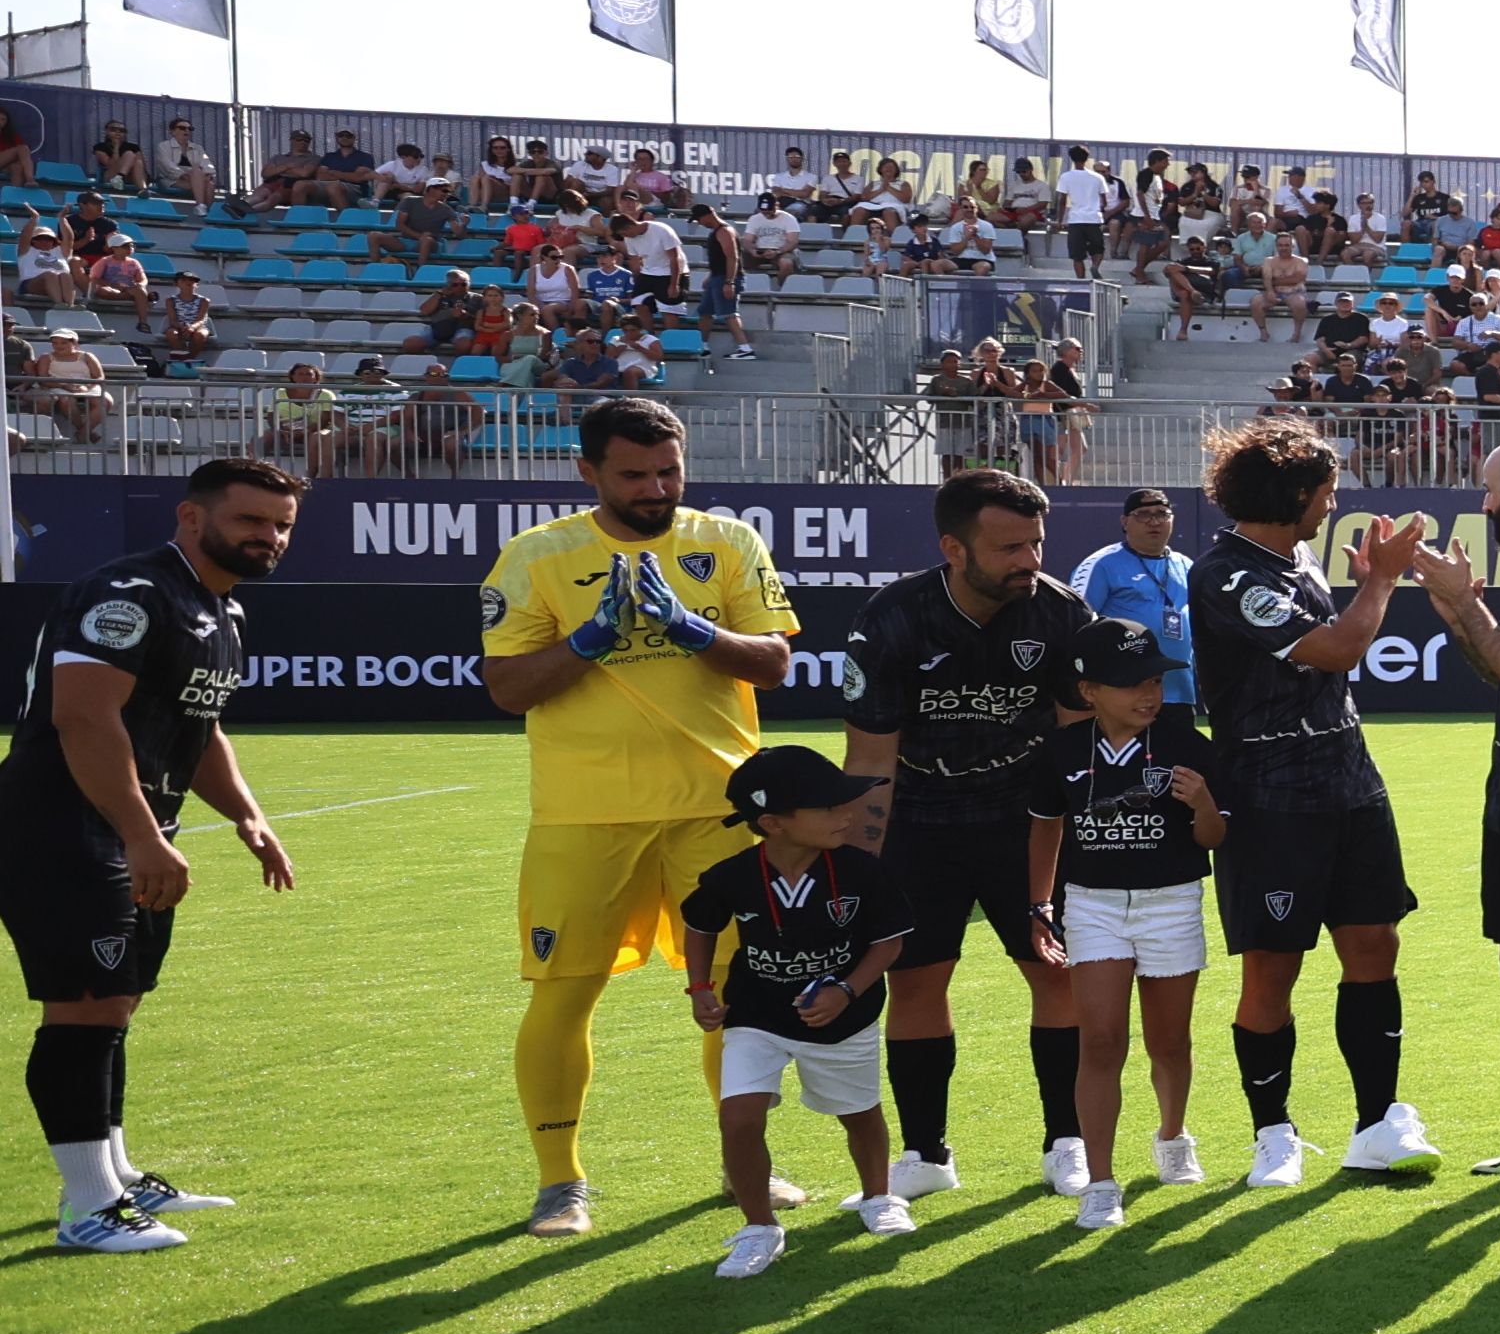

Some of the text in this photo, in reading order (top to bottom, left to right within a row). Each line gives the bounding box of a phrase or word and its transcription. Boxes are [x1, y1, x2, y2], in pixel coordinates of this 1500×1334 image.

[683, 142, 719, 166] EM
[671, 171, 778, 196] STRELAS
[352, 502, 477, 556] NUM
[793, 507, 868, 558] EM
[603, 649, 677, 666] SHOPPING
[188, 667, 242, 690] PALÁC
[240, 655, 483, 687] UPER BOCK
[179, 686, 215, 705] DO
[919, 698, 959, 714] DO
[929, 712, 996, 722] SHOPPING
[1074, 810, 1165, 828] PALÁCIO
[1076, 828, 1165, 841] DO GELO
[1129, 841, 1158, 850] VISEU
[749, 953, 852, 975] DO GELO
